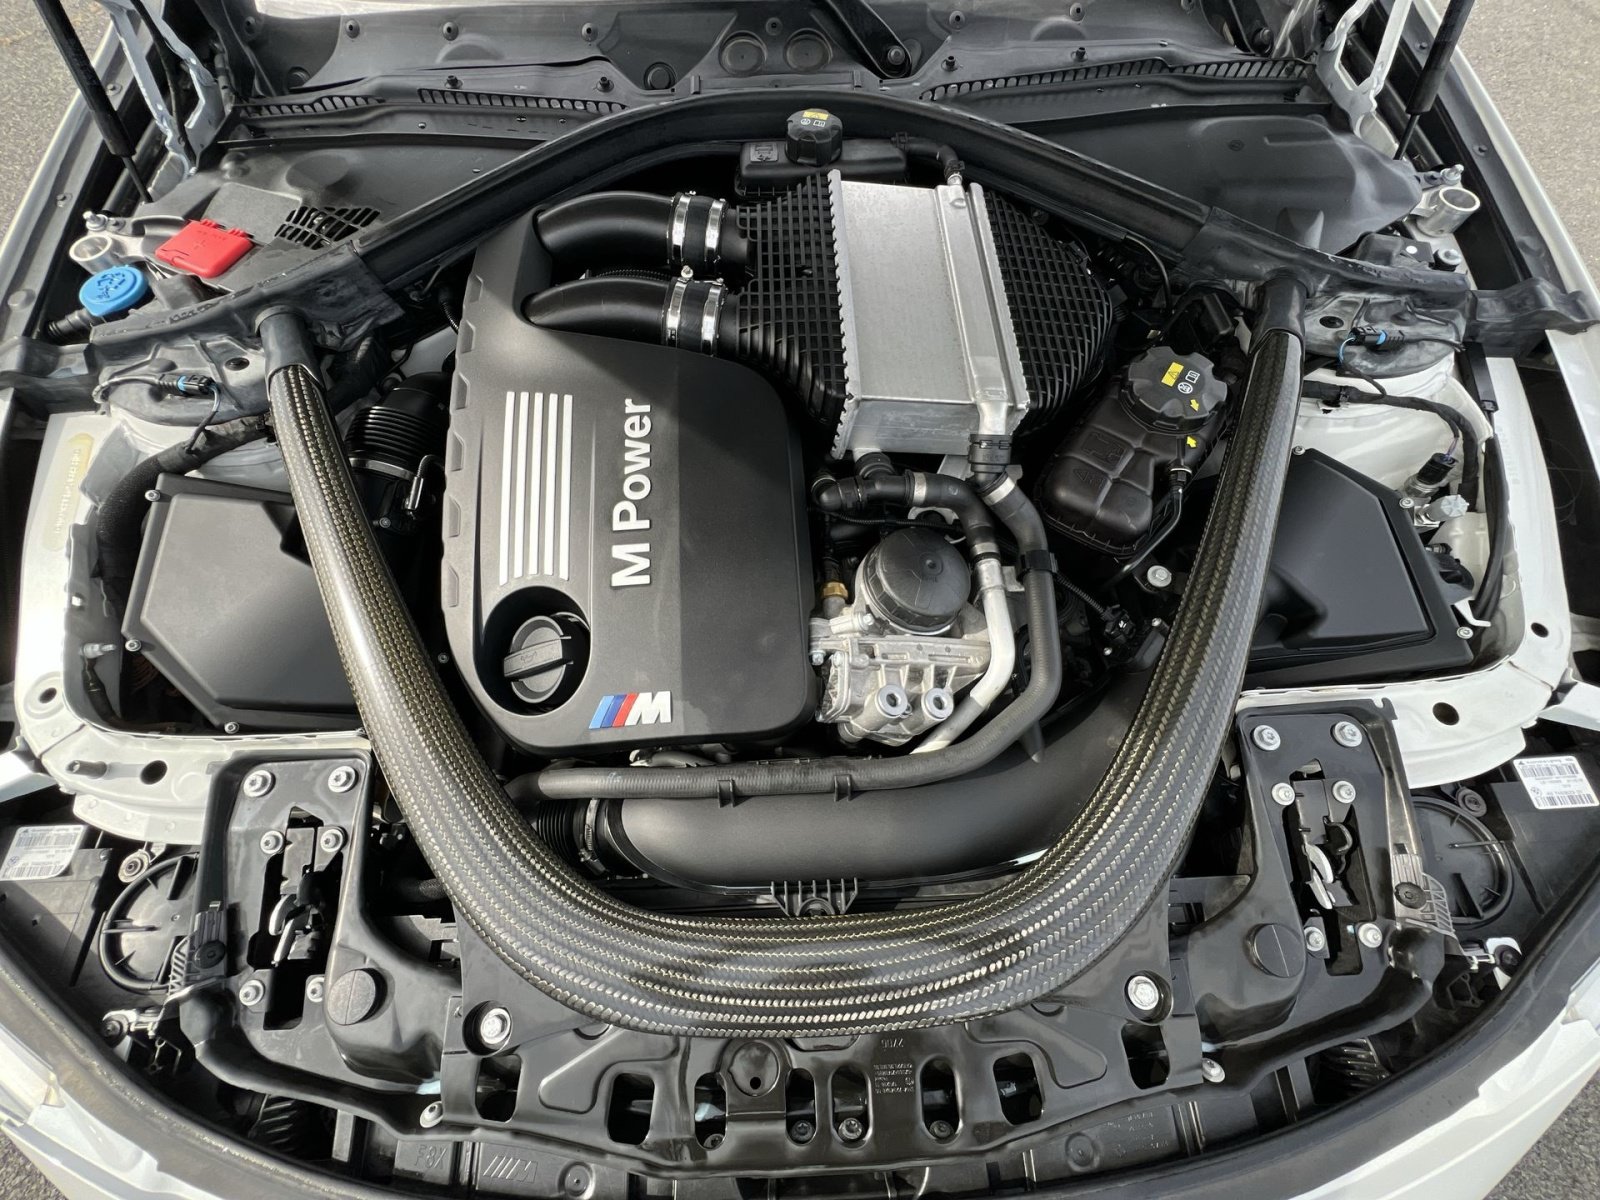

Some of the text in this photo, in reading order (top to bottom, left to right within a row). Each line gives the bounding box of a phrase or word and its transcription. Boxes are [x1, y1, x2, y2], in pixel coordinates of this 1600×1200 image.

[611, 398, 652, 587] M Power
[624, 690, 672, 727] M
